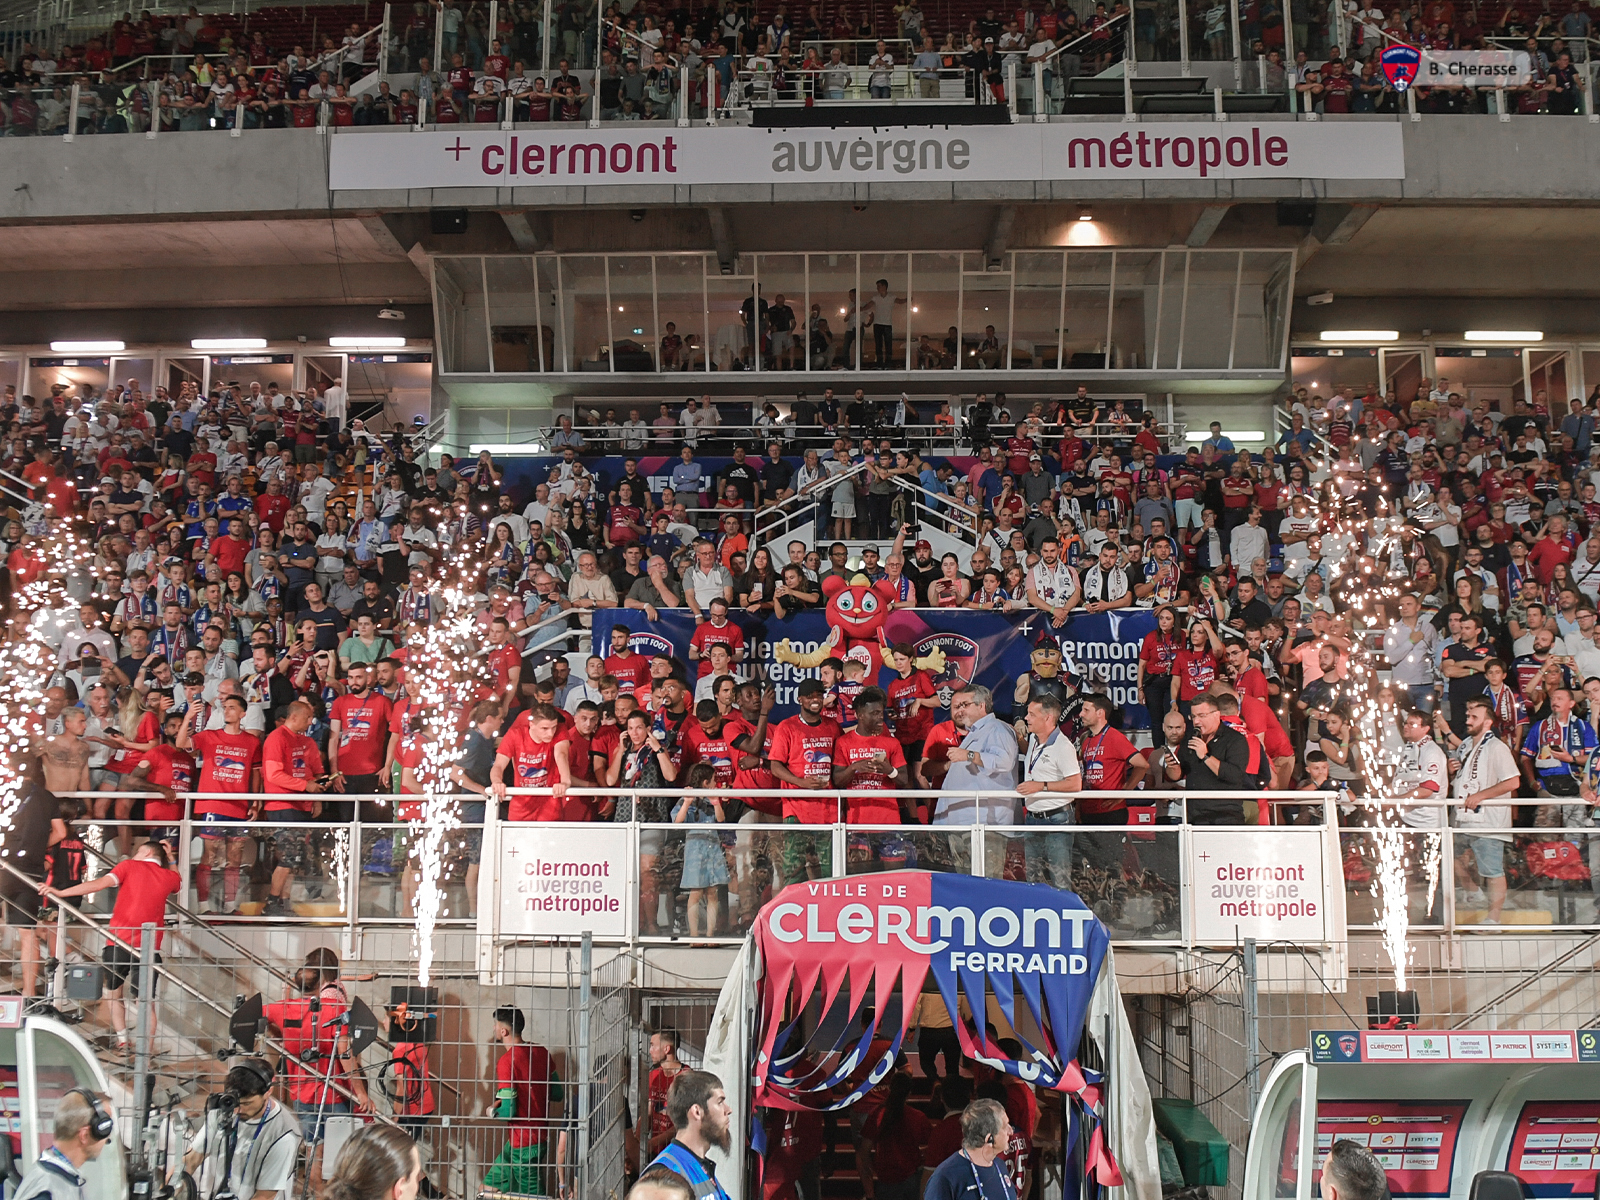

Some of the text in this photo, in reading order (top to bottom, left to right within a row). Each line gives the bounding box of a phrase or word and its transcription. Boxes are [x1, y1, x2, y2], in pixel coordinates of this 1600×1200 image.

[481, 127, 1288, 177] clermont auvergne métropole
[650, 640, 668, 652] FOOT
[919, 638, 974, 653] CLERMONT FOOT
[940, 692, 952, 700] 63
[524, 859, 610, 876] clermont
[1217, 863, 1304, 880] clermont
[518, 880, 603, 895] auvergne
[808, 884, 907, 898] VILLE DE
[1211, 884, 1298, 900] auvergne
[526, 895, 619, 916] métropole
[1220, 899, 1316, 921] métropole
